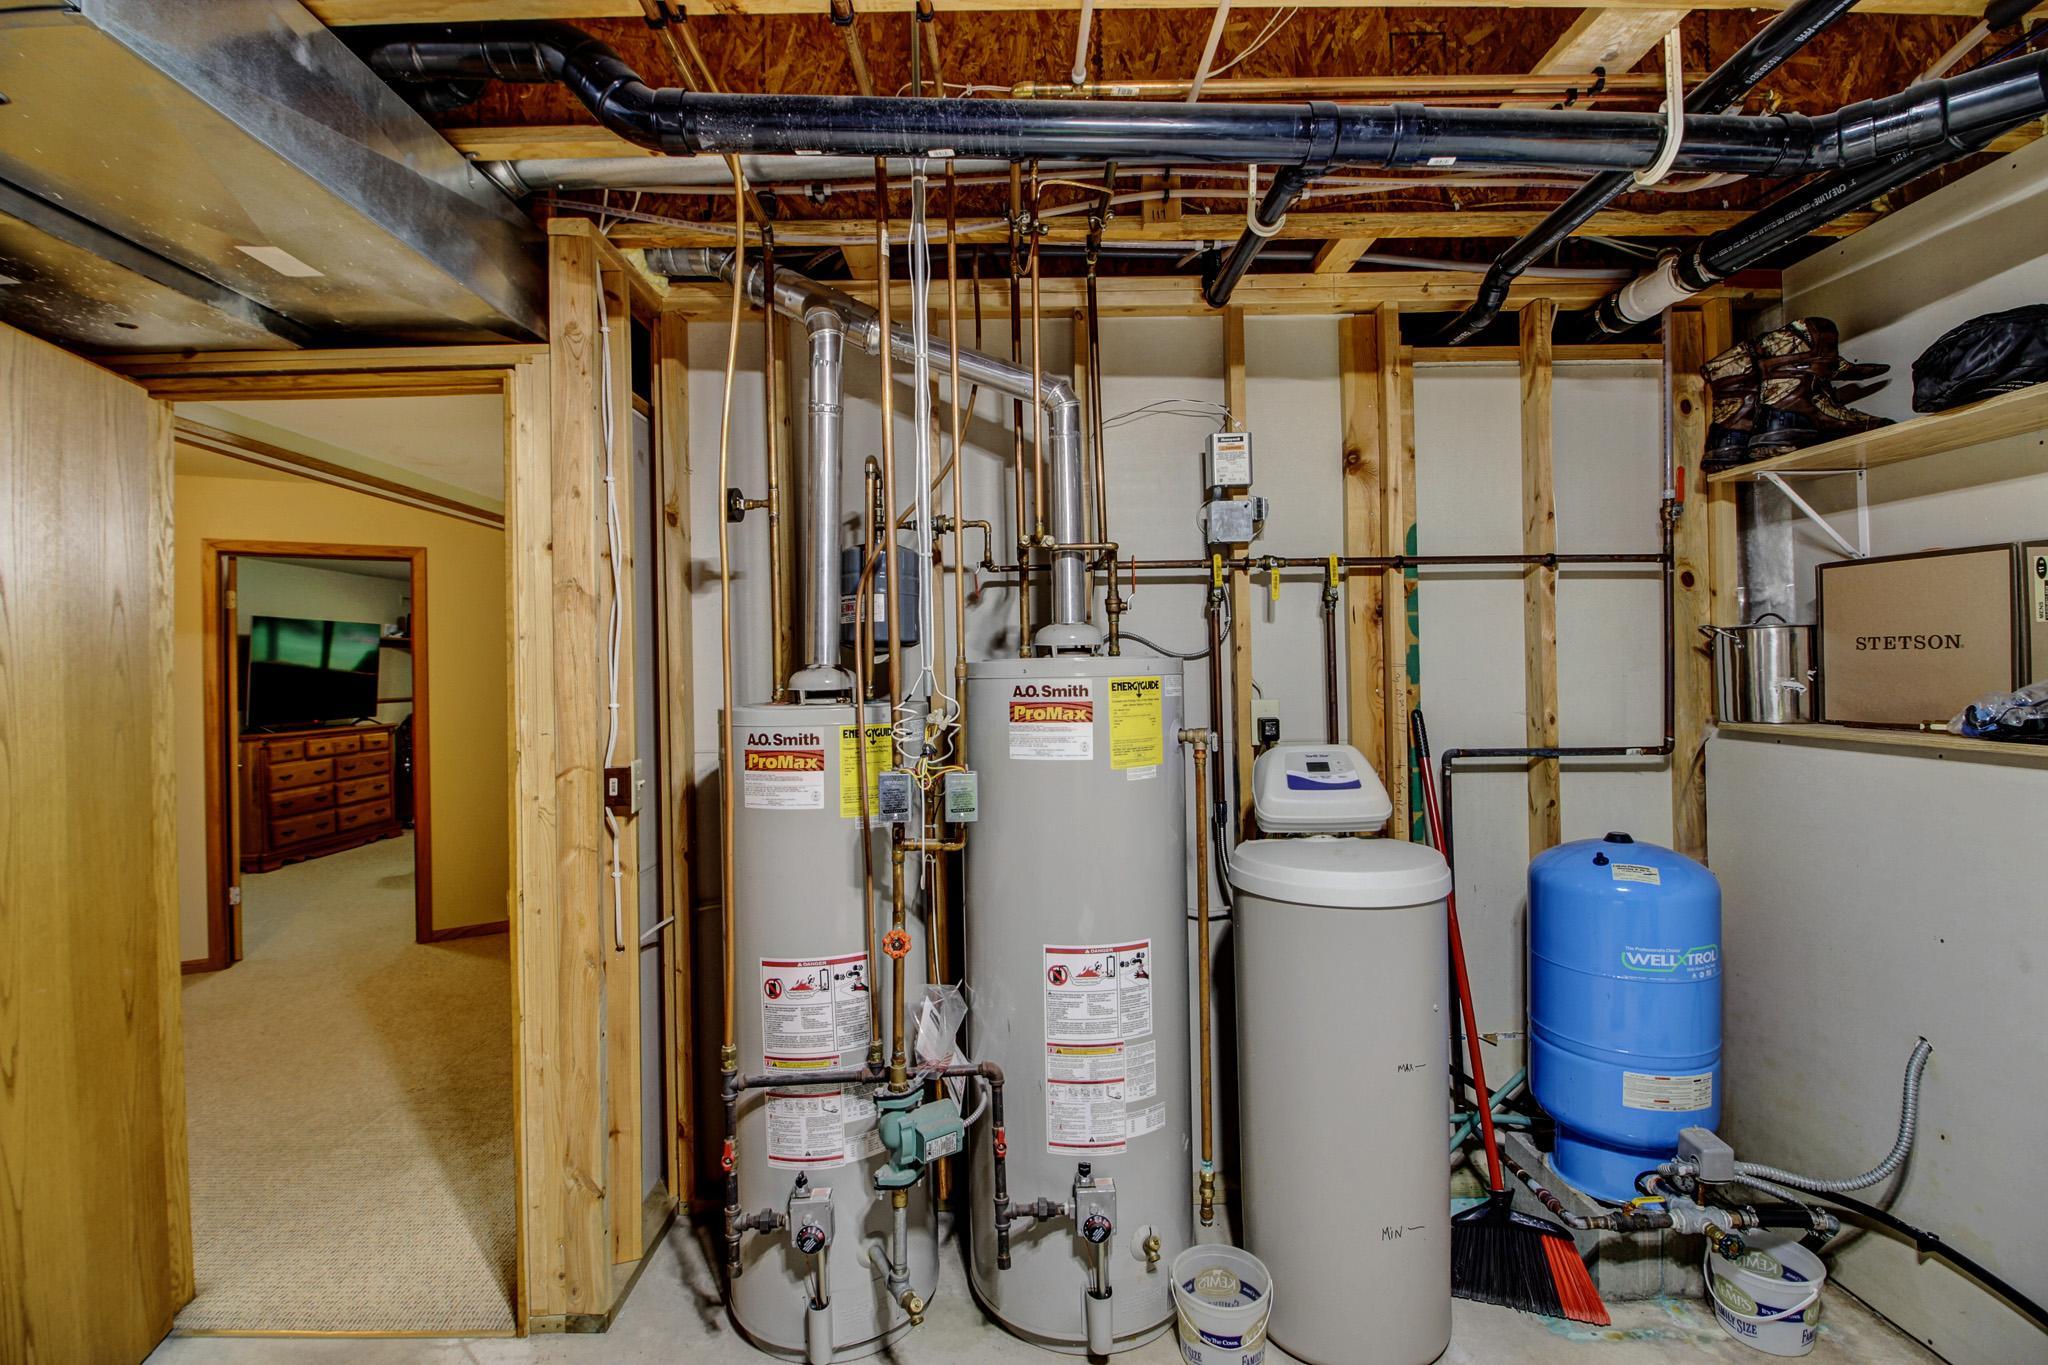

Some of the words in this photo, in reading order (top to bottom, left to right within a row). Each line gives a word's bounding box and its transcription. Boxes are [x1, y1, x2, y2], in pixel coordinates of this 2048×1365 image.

[1856, 634, 1962, 650] STETSON
[1013, 685, 1039, 698] A.O.
[1041, 684, 1089, 698] Smith
[1111, 680, 1159, 692] ENERGYGUIDE
[1014, 705, 1087, 720] ProMax
[747, 733, 771, 746] A.O.
[772, 733, 820, 746] Smith
[748, 753, 818, 769] ProMax
[1736, 1318, 1758, 1335] SIZE
